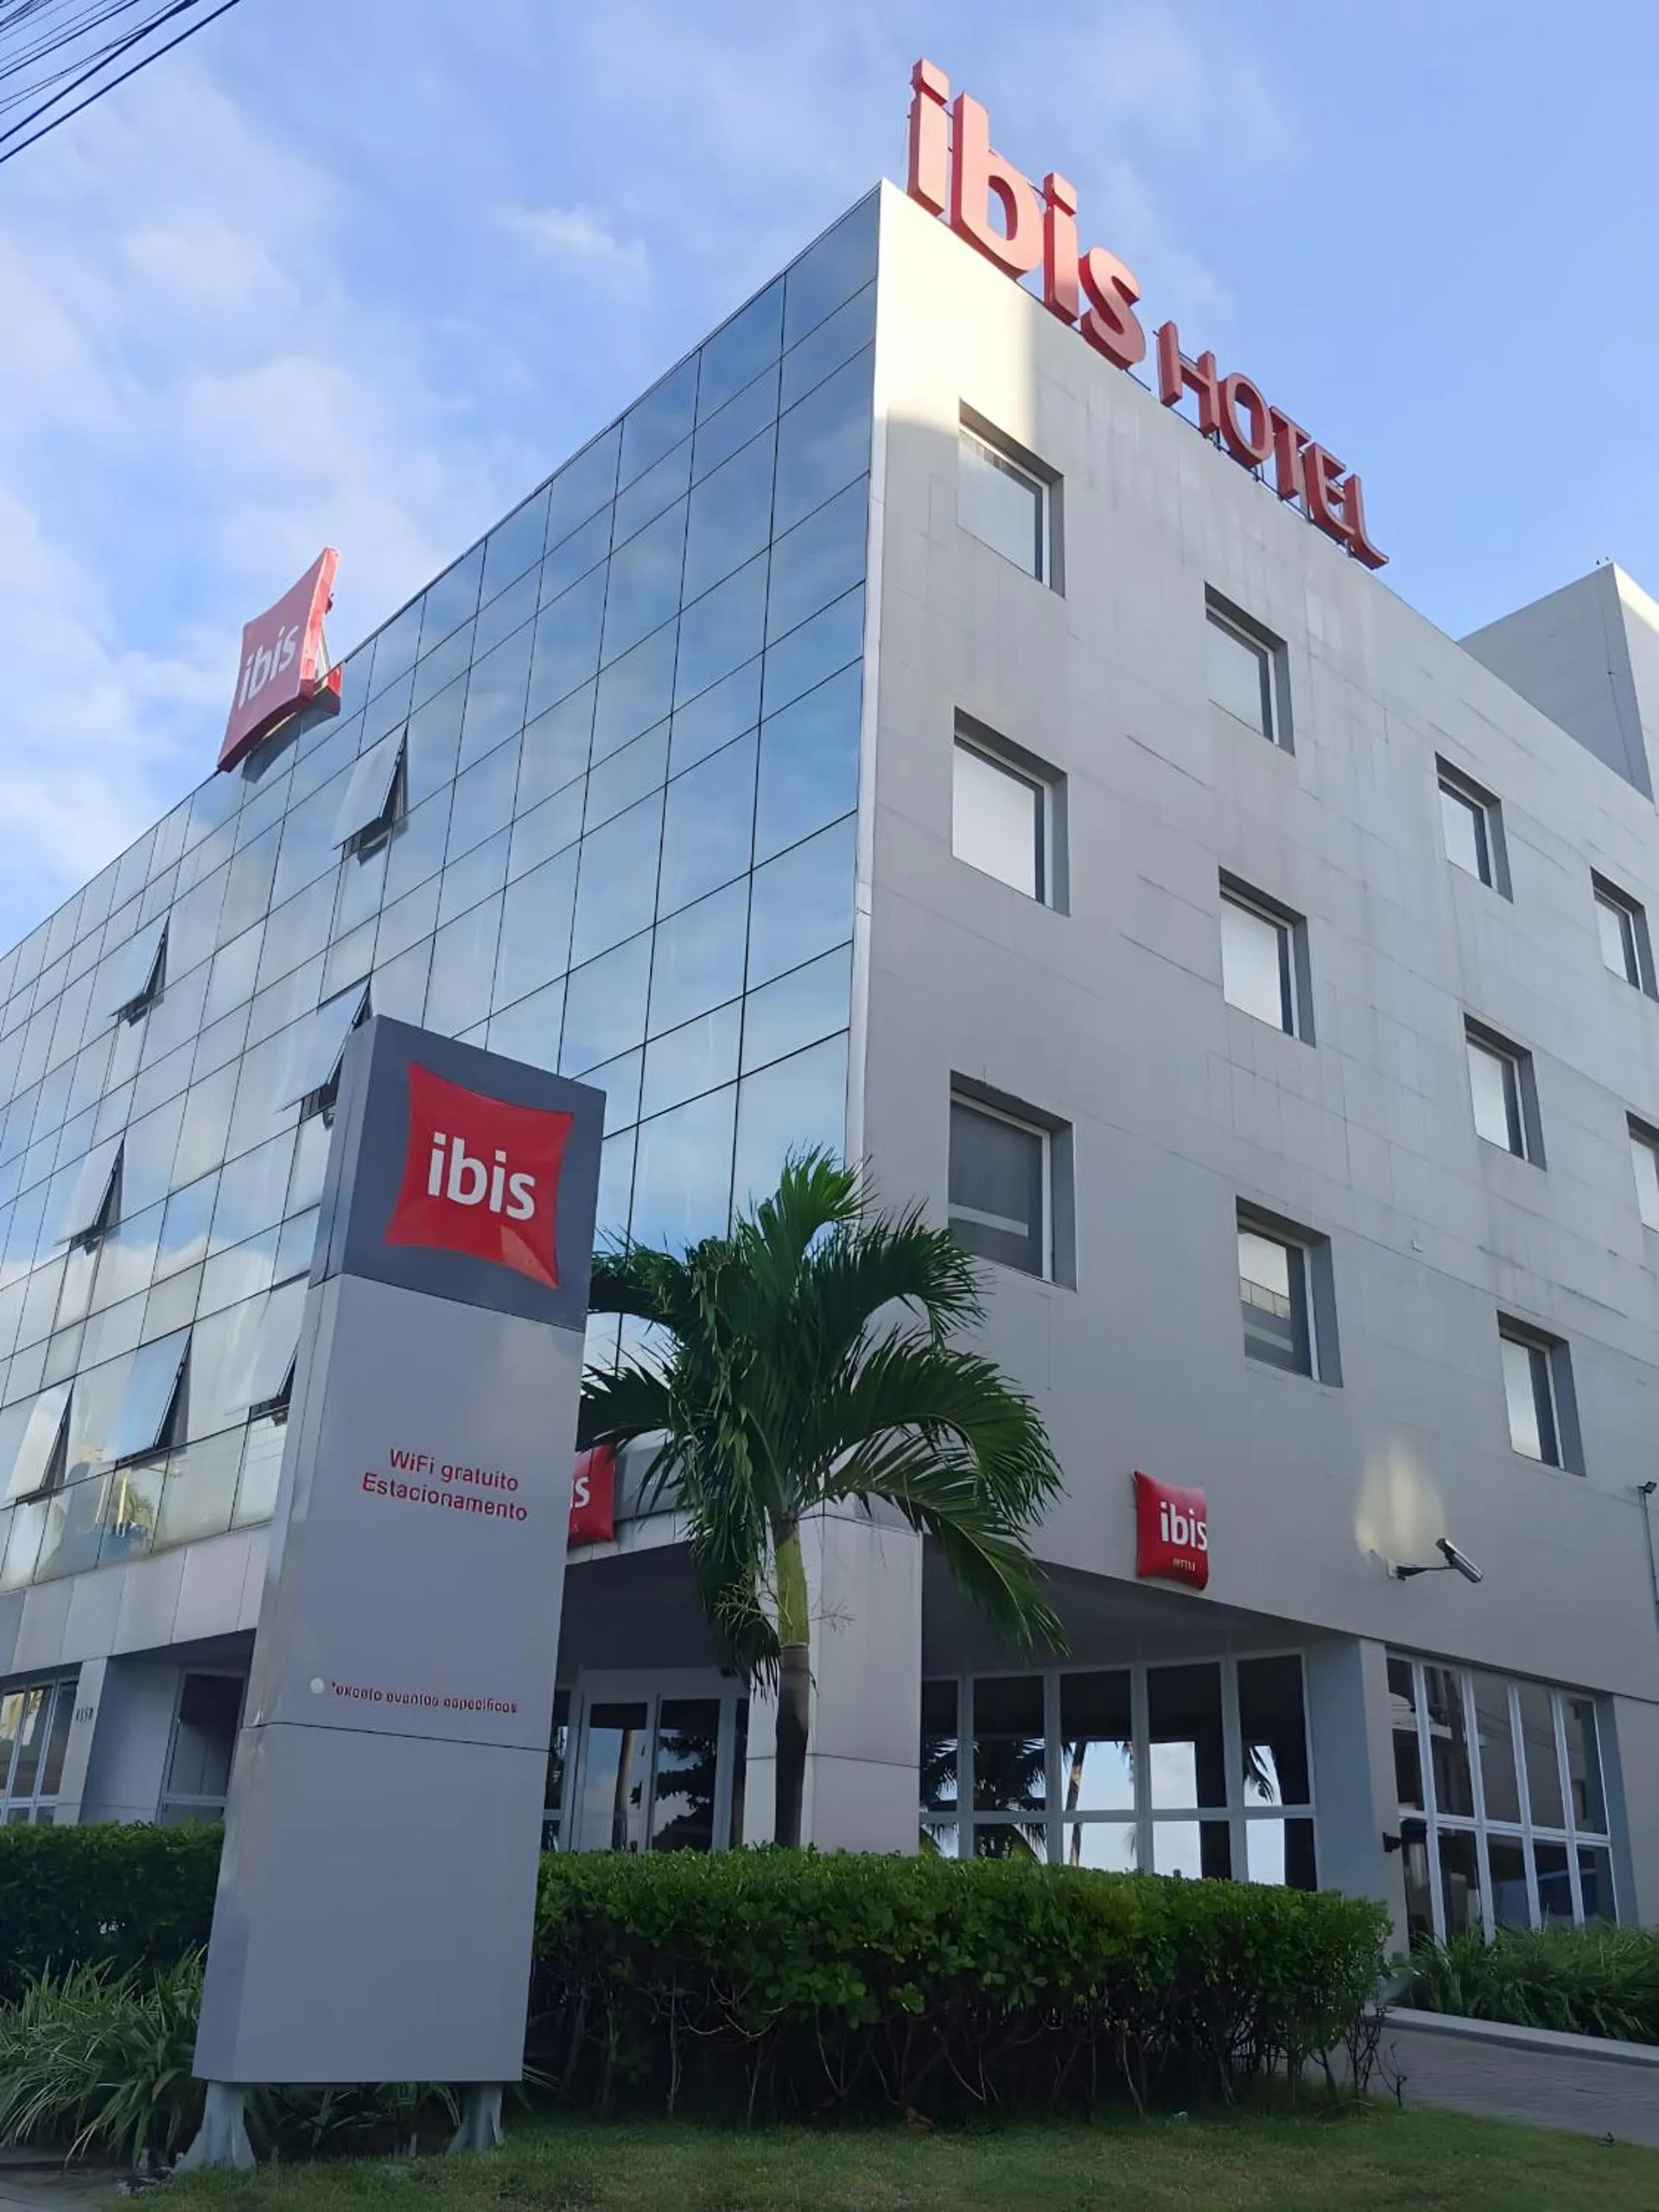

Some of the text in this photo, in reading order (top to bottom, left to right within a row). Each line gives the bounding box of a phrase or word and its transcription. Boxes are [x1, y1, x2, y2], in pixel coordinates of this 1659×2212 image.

[906, 57, 1389, 570] ibis HOTEL
[238, 624, 300, 709] ibis
[428, 1131, 536, 1221] ibis
[362, 1471, 528, 1521] Estacionamento
[390, 1448, 518, 1491] WiFi gratuito
[1160, 1500, 1208, 1551] ibis
